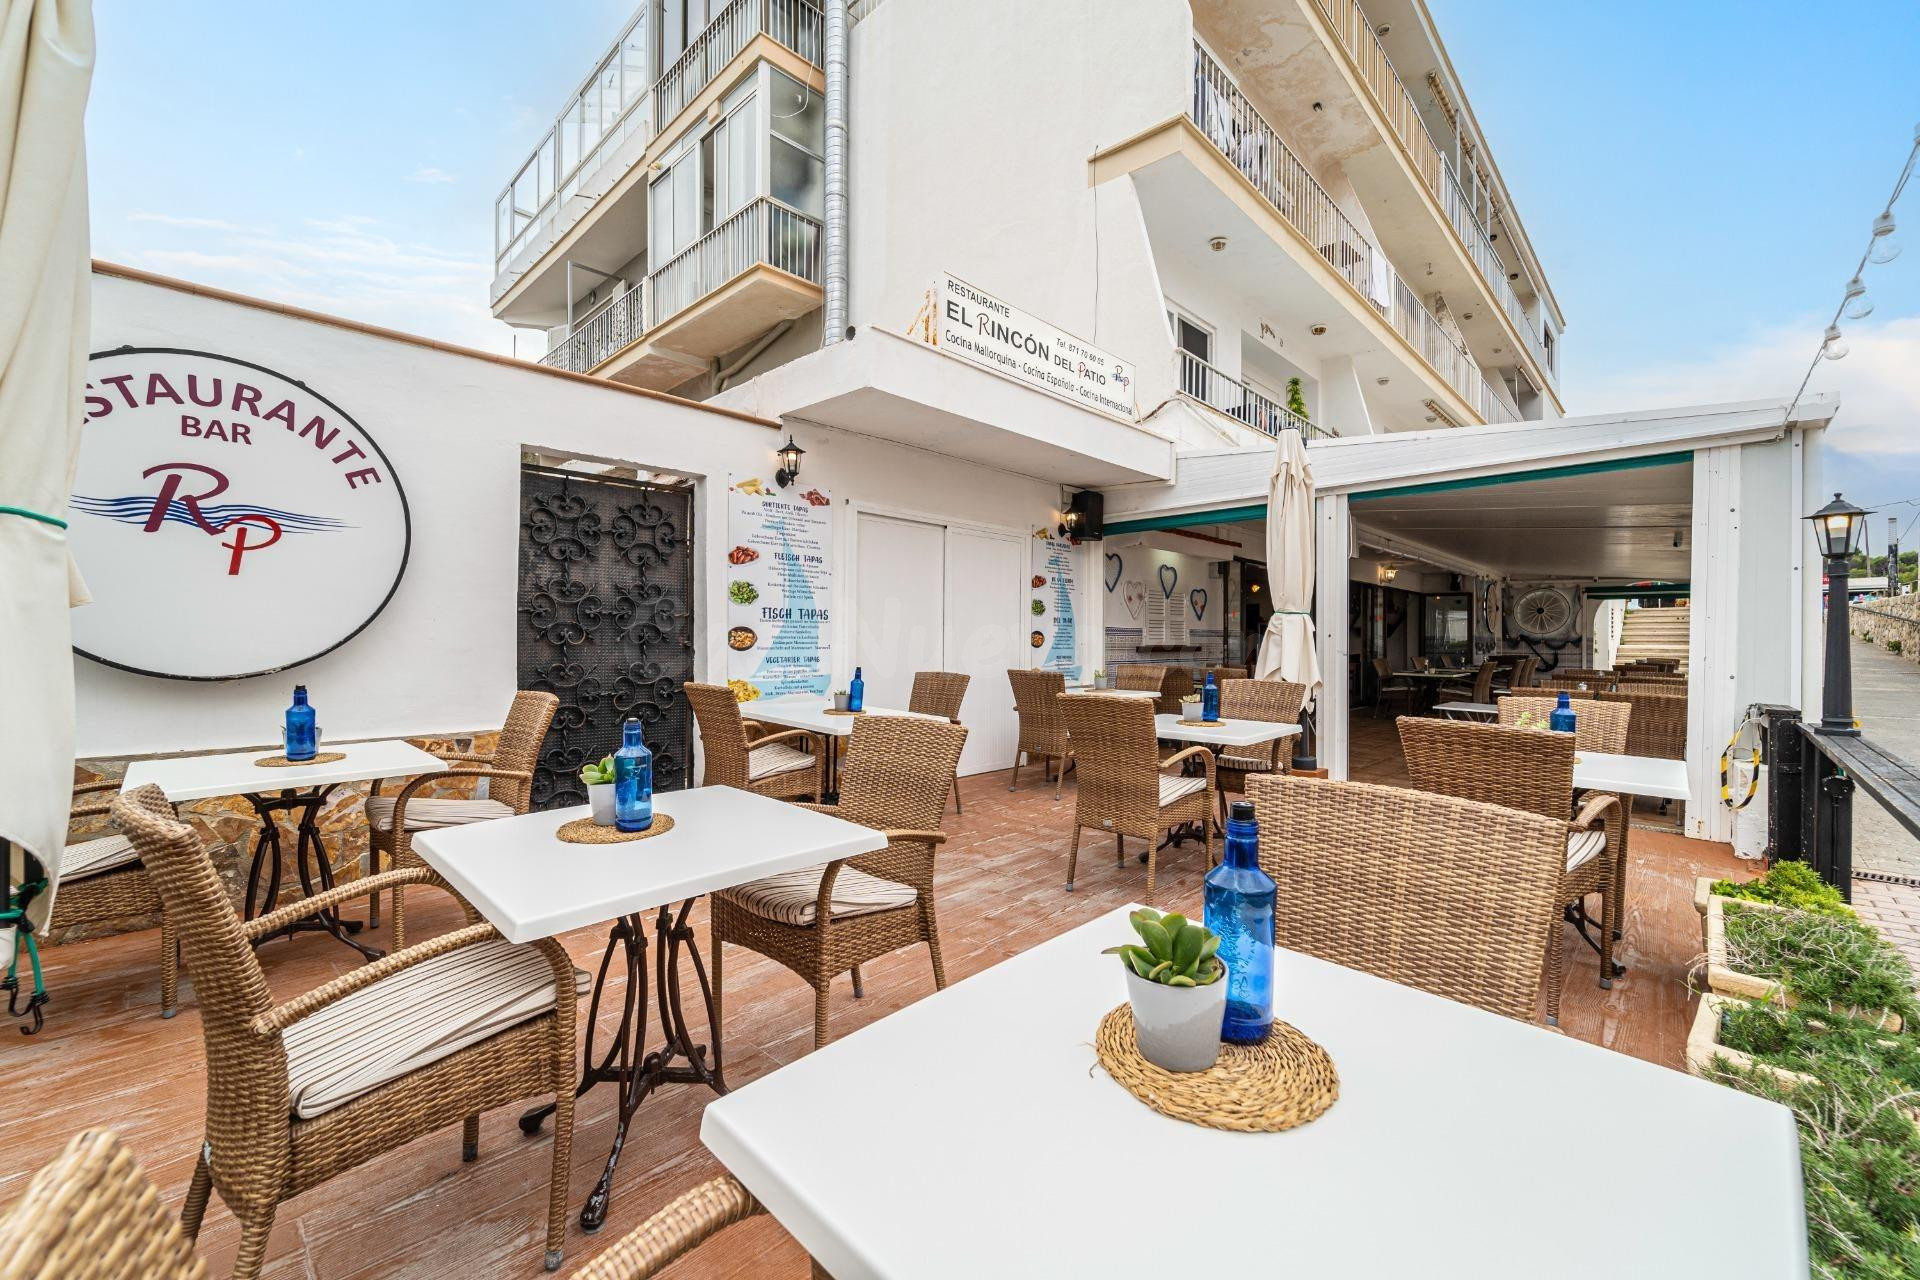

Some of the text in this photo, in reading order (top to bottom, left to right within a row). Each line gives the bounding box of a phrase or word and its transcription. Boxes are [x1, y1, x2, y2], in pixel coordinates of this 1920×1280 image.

[947, 279, 1010, 318] RESTAURANTE
[946, 299, 1106, 386] EL RINCÓN DEL PATIO
[945, 329, 972, 350] Cocina
[974, 341, 1017, 369] Mallorquina
[1023, 362, 1045, 380] Cocina
[1080, 385, 1099, 402] Cocina
[1099, 393, 1133, 416] Internacional
[83, 373, 382, 490] STAURANTE
[181, 415, 252, 445] BAR
[774, 552, 823, 563] FLEISCH TAPAS
[762, 607, 829, 620] FISCH TAPAS
[765, 656, 801, 664] VEGETARIER
